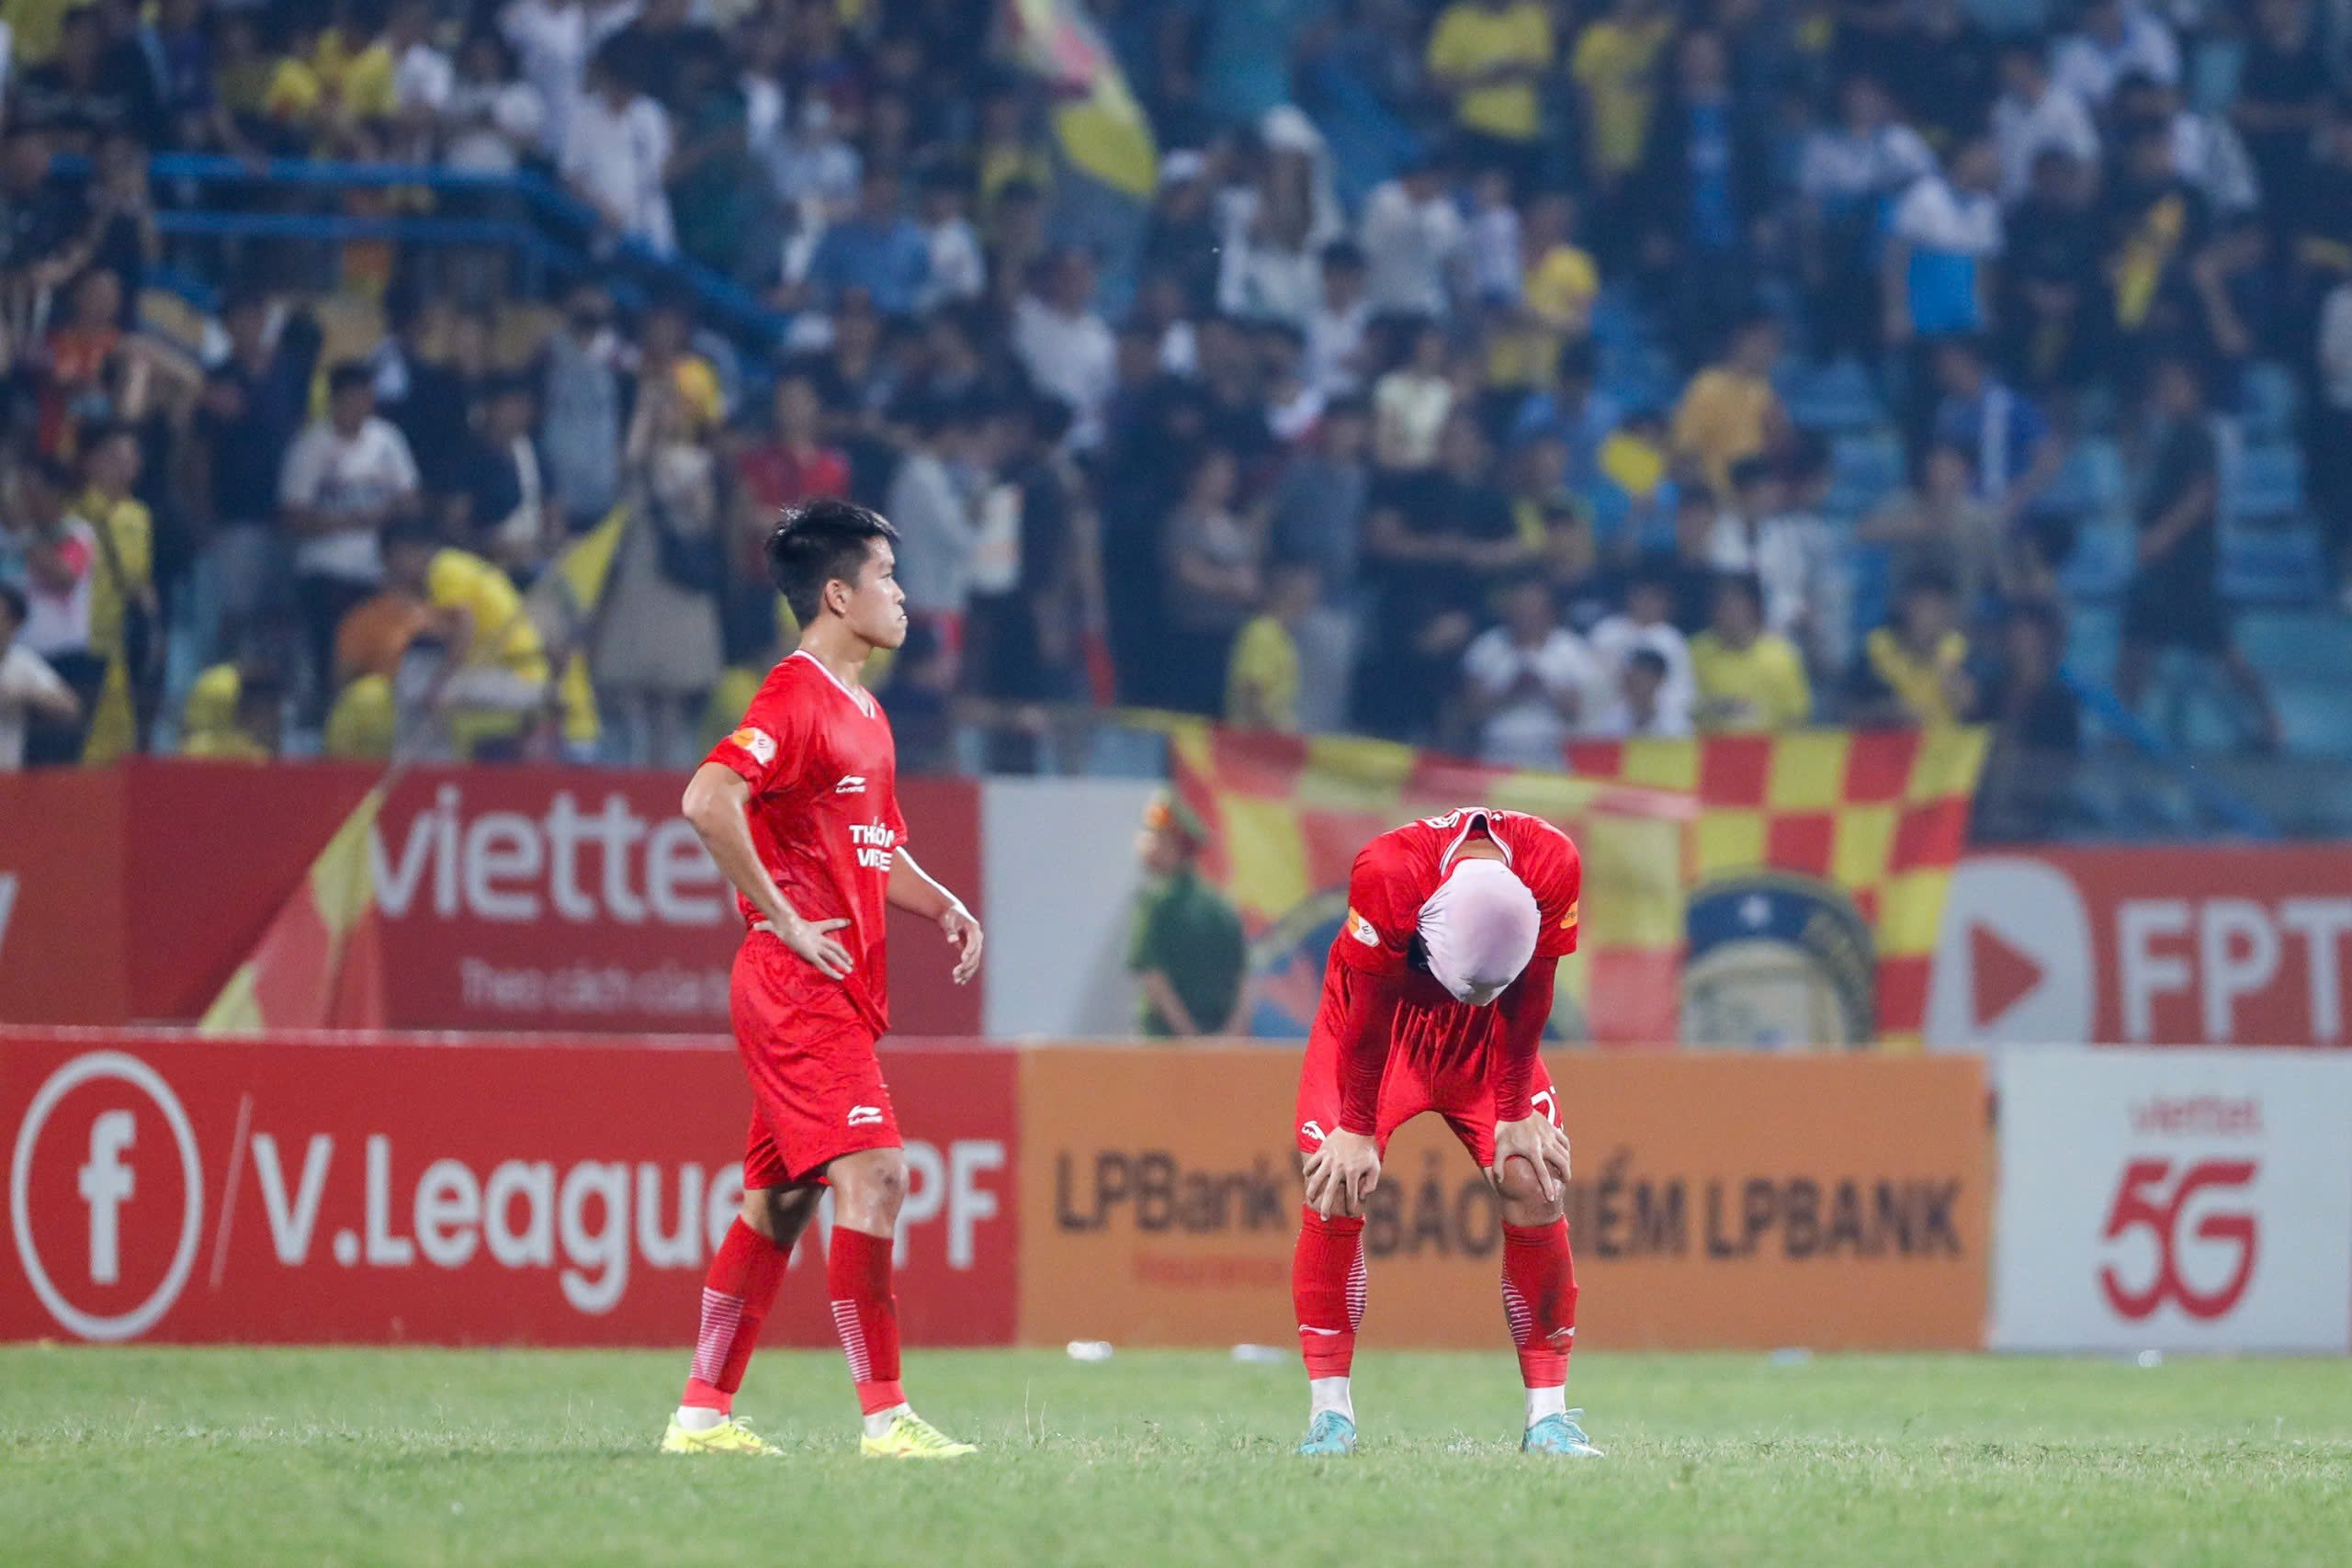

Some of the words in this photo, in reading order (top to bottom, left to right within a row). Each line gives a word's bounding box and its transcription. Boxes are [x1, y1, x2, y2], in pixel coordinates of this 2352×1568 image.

[371, 784, 741, 923] viette
[2118, 897, 2352, 1043] FPT
[1055, 1148, 1289, 1235] LPBank
[1705, 1177, 1964, 1259] LPBANK
[2097, 1155, 2260, 1323] 5G
